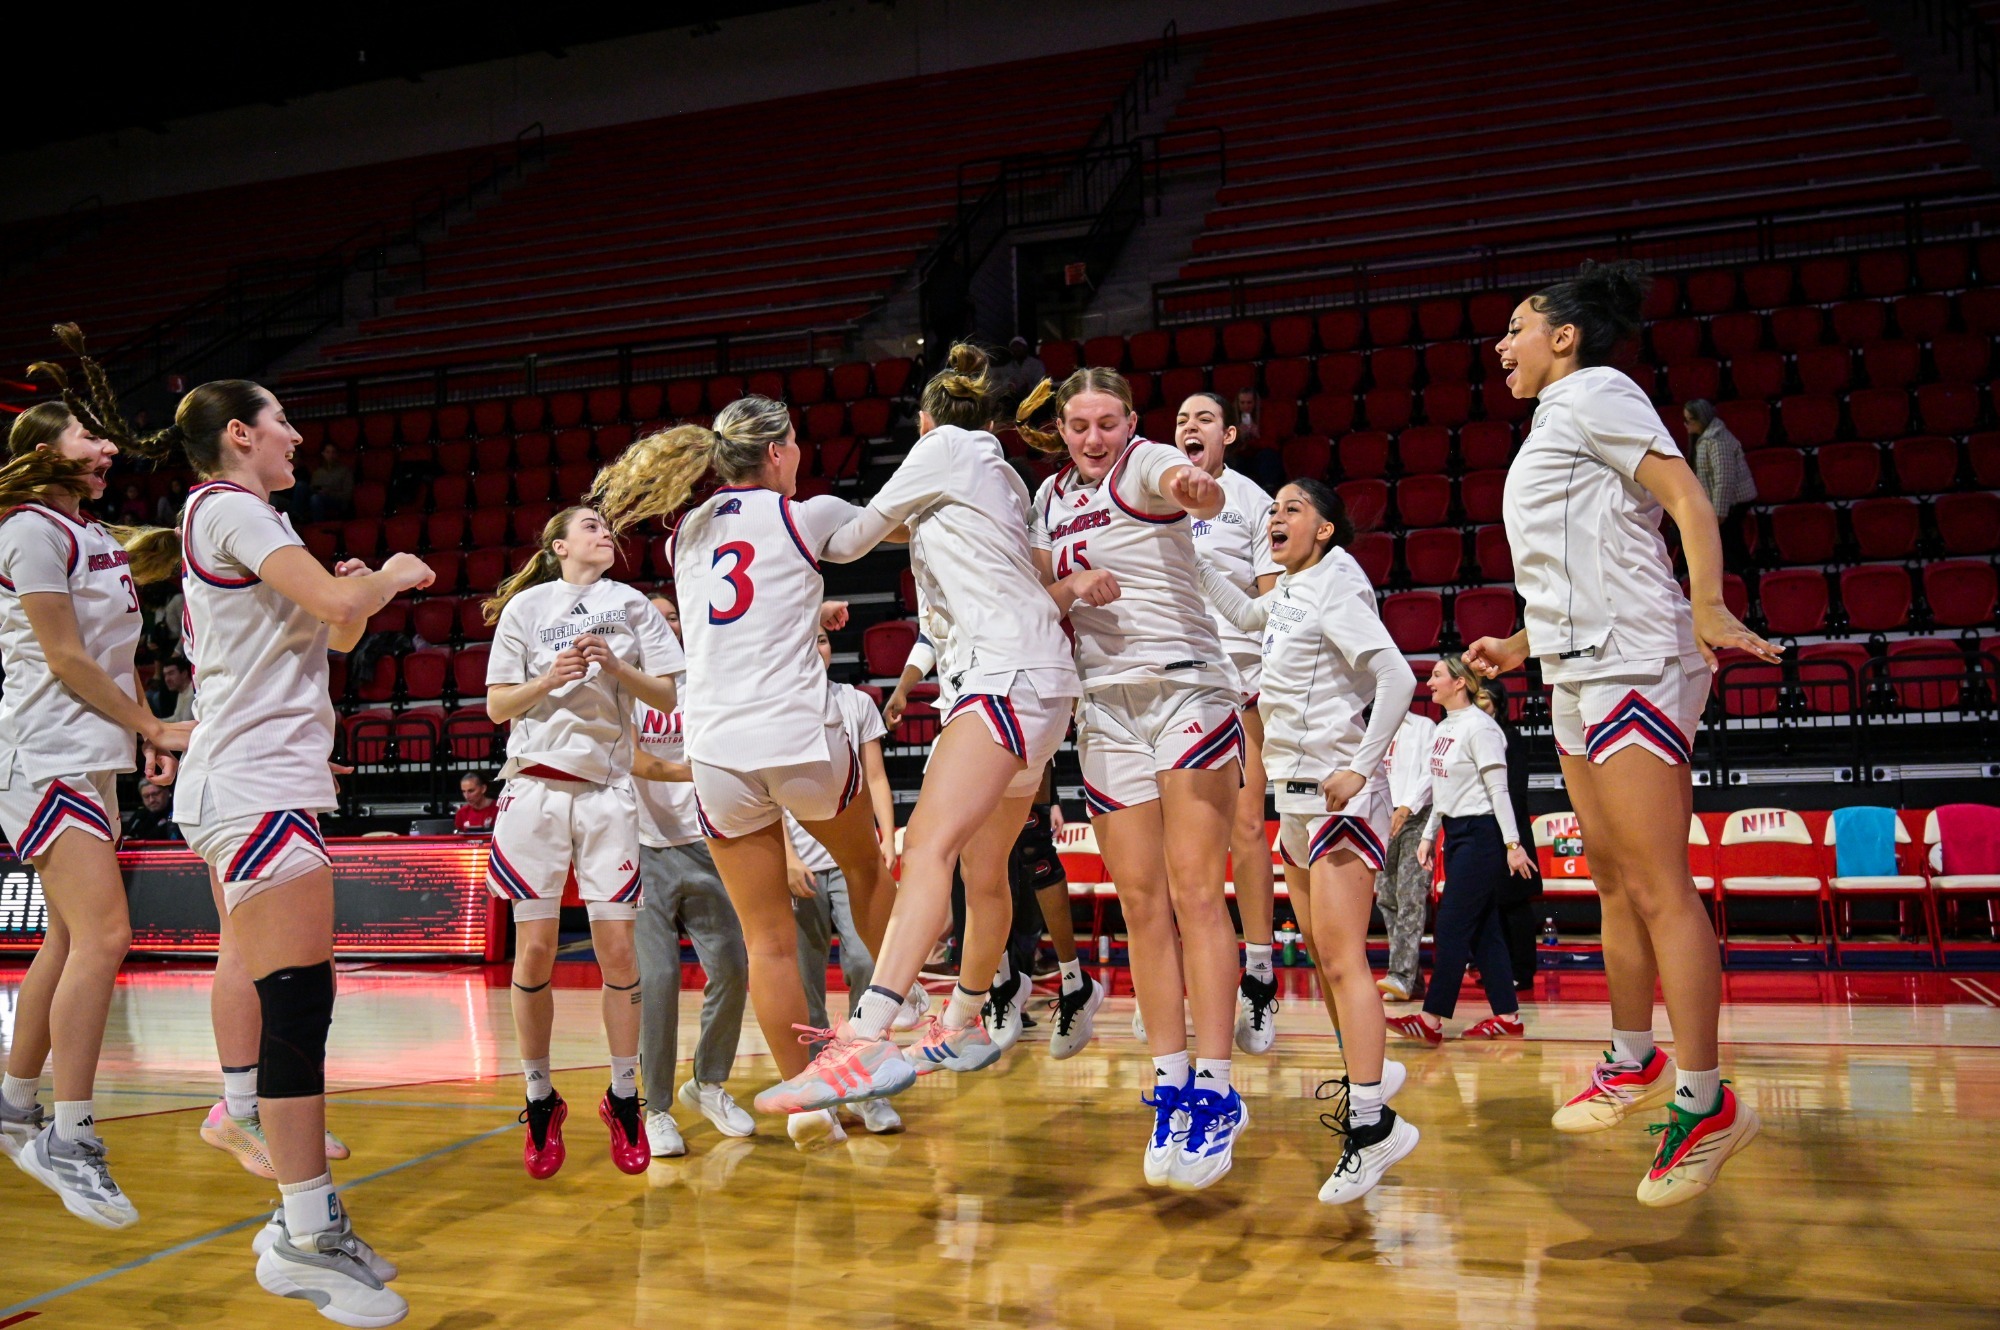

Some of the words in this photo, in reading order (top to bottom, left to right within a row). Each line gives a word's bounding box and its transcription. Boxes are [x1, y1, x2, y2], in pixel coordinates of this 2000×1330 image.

[119, 574, 139, 614] 3
[708, 540, 756, 625] 3
[540, 609, 627, 643] HIGHLNDERS
[1056, 826, 1089, 846] NJIT
[1741, 811, 1788, 835] NJIT
[1563, 859, 1576, 875] G
